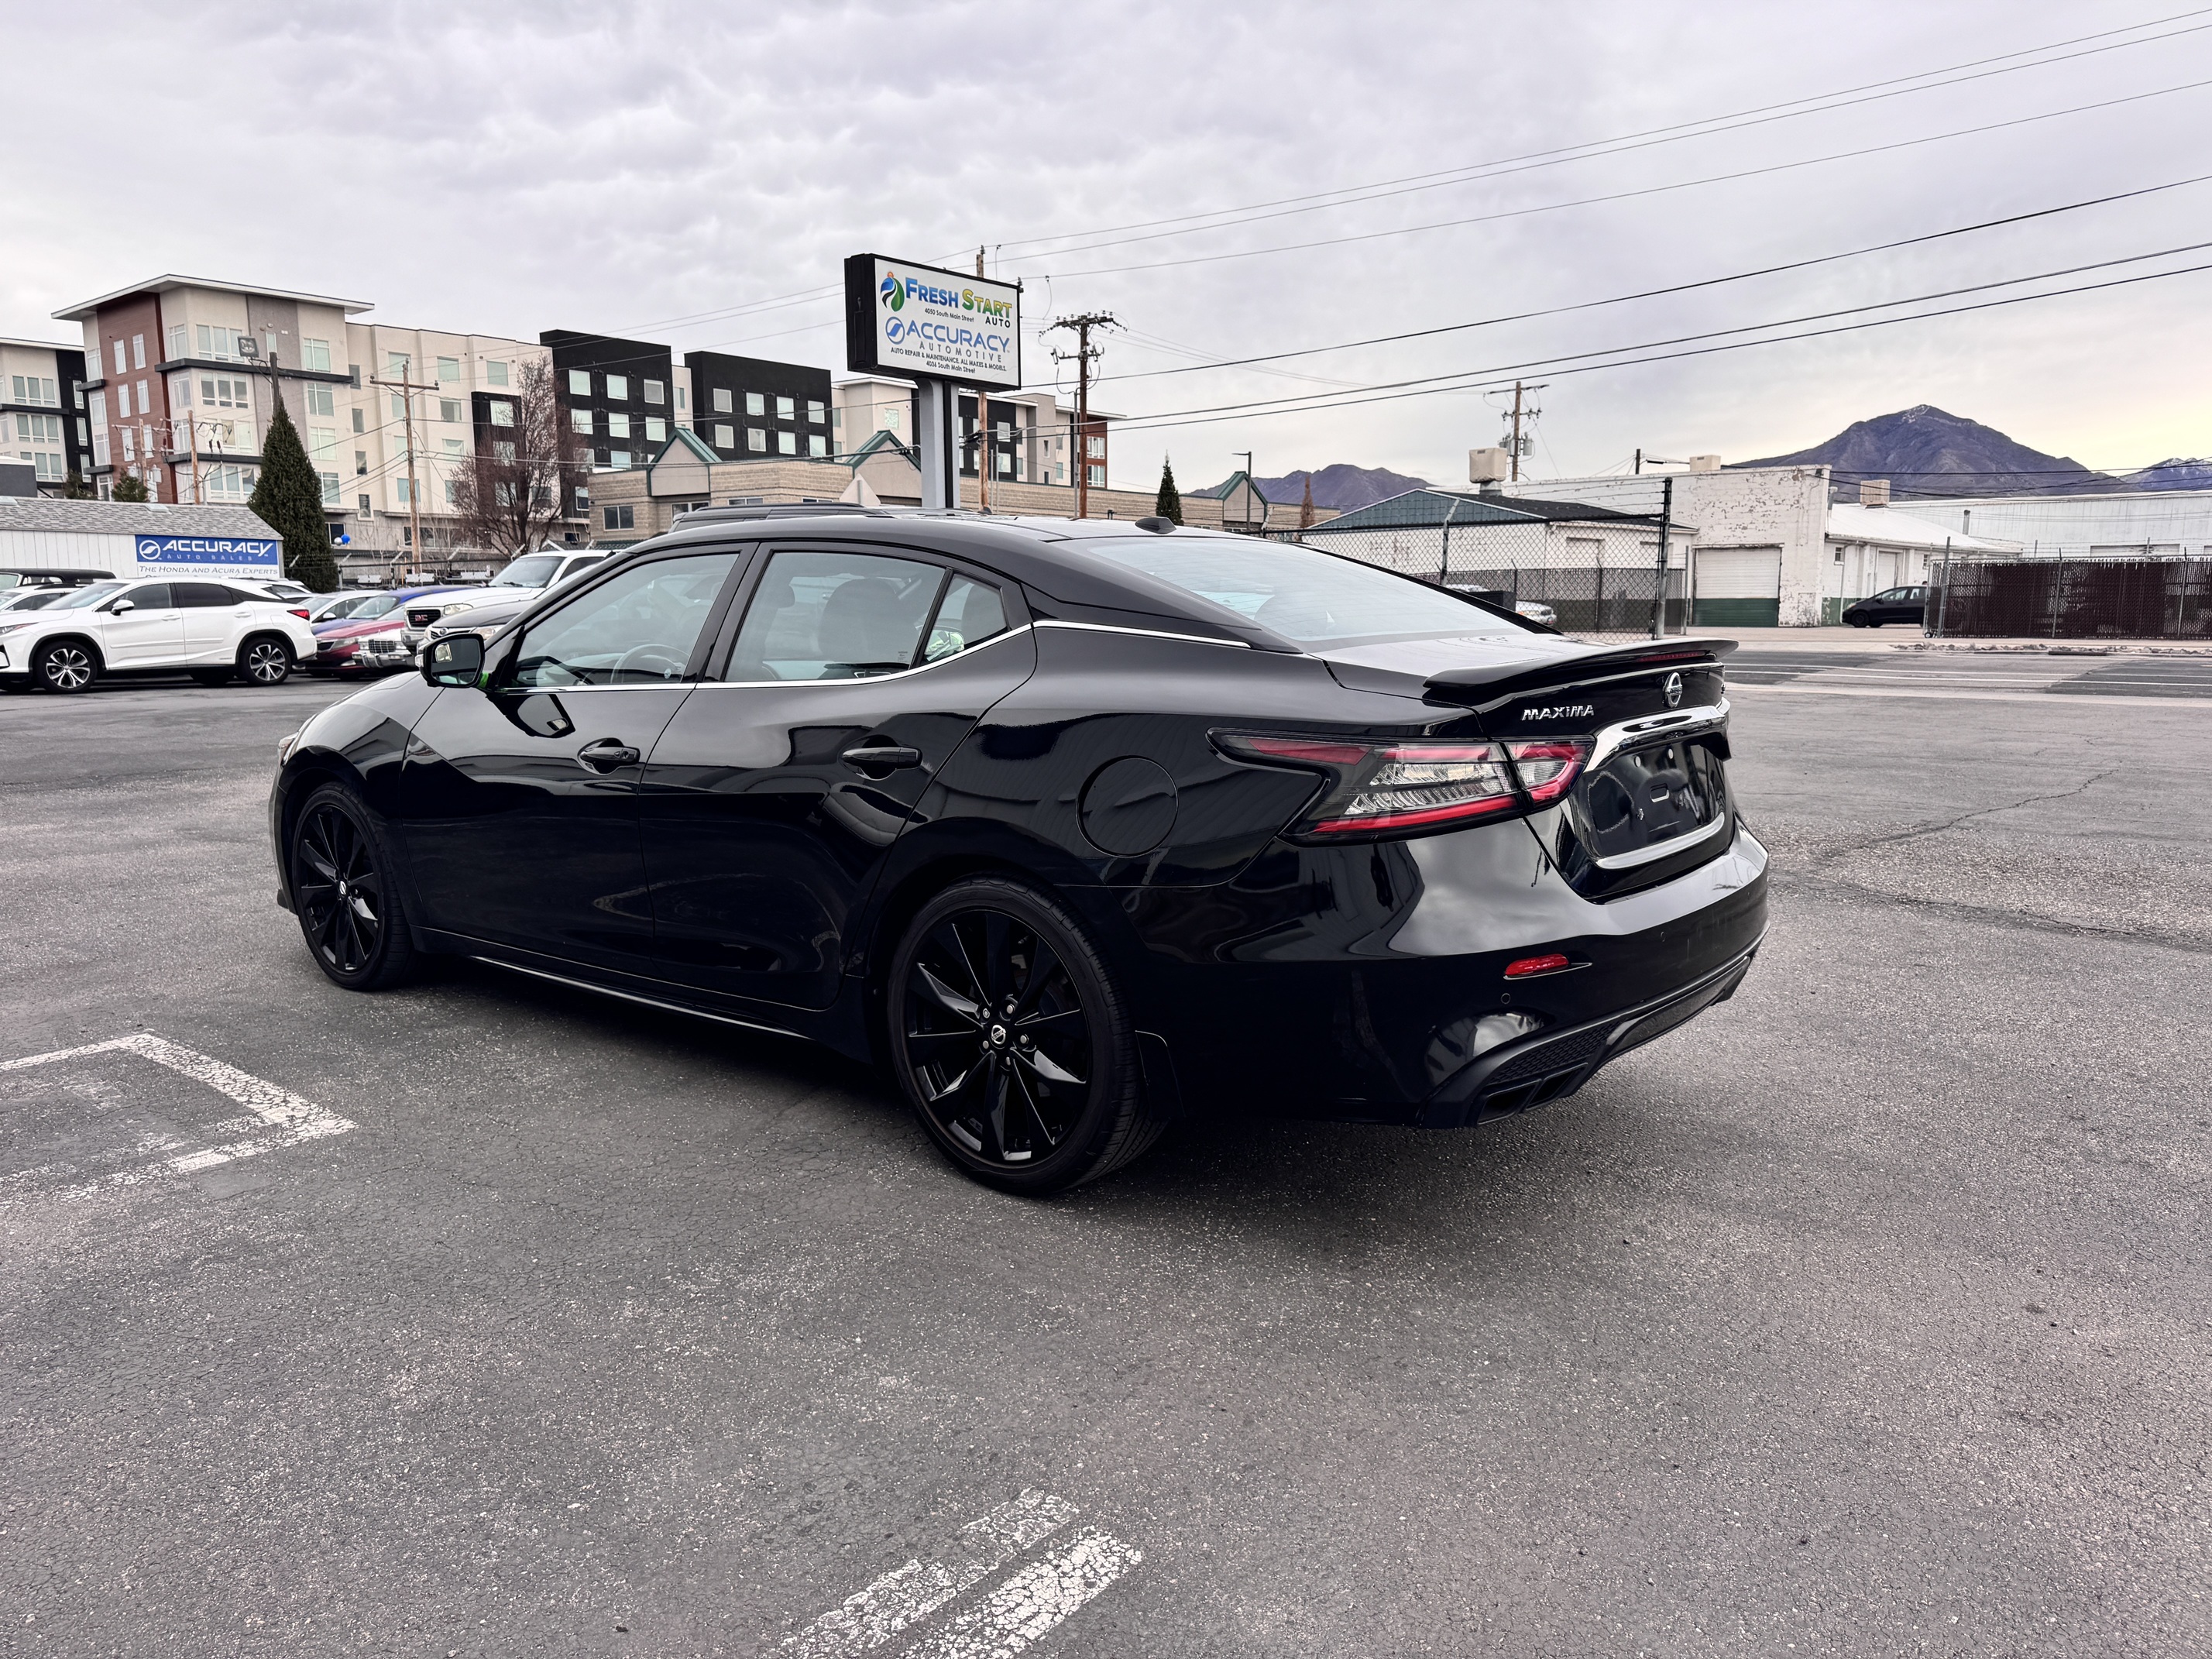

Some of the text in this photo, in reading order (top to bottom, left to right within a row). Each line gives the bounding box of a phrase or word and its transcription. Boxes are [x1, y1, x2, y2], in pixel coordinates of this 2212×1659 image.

[905, 277, 1012, 318] FRESH START
[985, 316, 1011, 328] AUTO
[906, 319, 1009, 353] ACCURACY
[905, 349, 920, 358] REPAIR
[919, 341, 1001, 362] AUTOMOTIVE
[163, 540, 273, 557] ACCURACY
[1521, 705, 1595, 721] MAXIMA
